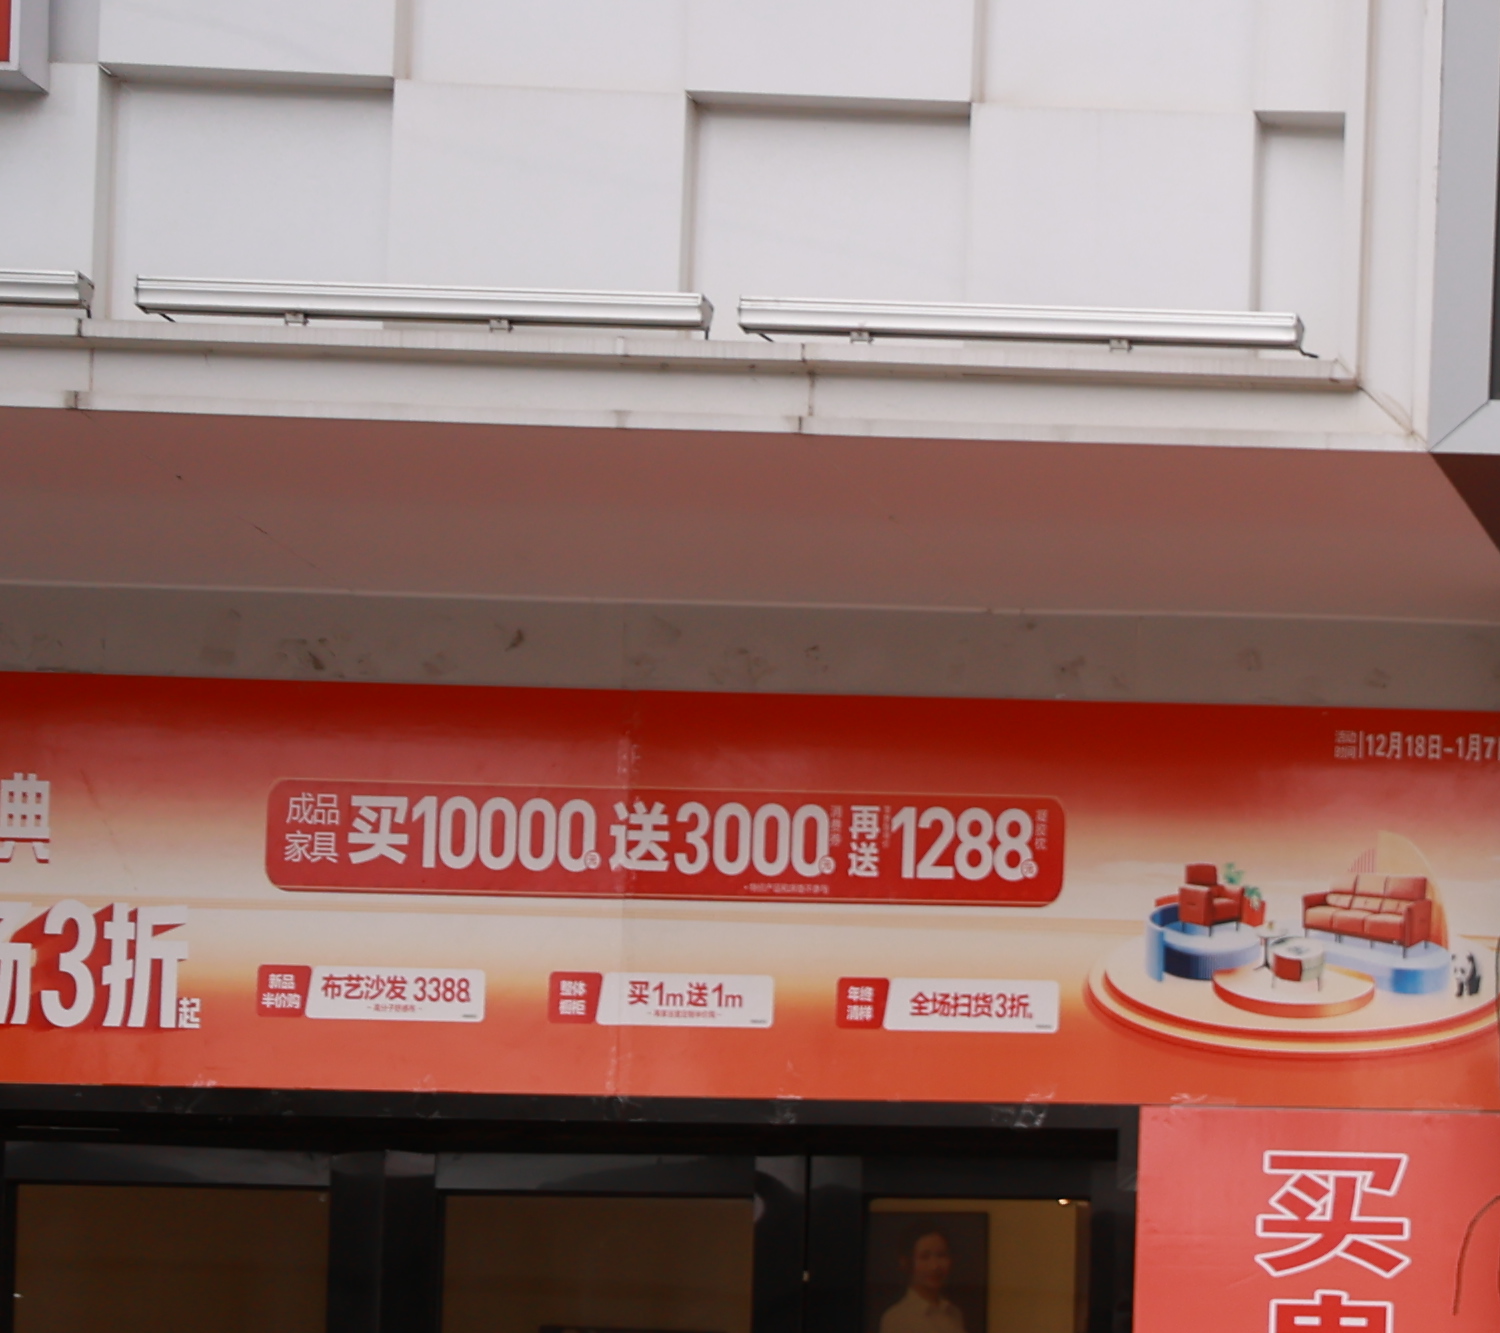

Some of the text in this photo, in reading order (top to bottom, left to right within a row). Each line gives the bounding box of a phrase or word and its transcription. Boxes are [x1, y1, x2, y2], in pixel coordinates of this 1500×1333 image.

[286, 792, 339, 826] 成品
[283, 830, 339, 864] 家具
[847, 804, 881, 879] 再送
[321, 973, 472, 1004] 布艺沙发 3388
[627, 979, 744, 1009] 买1m送1m
[909, 991, 1034, 1020] 全场扫货3折
